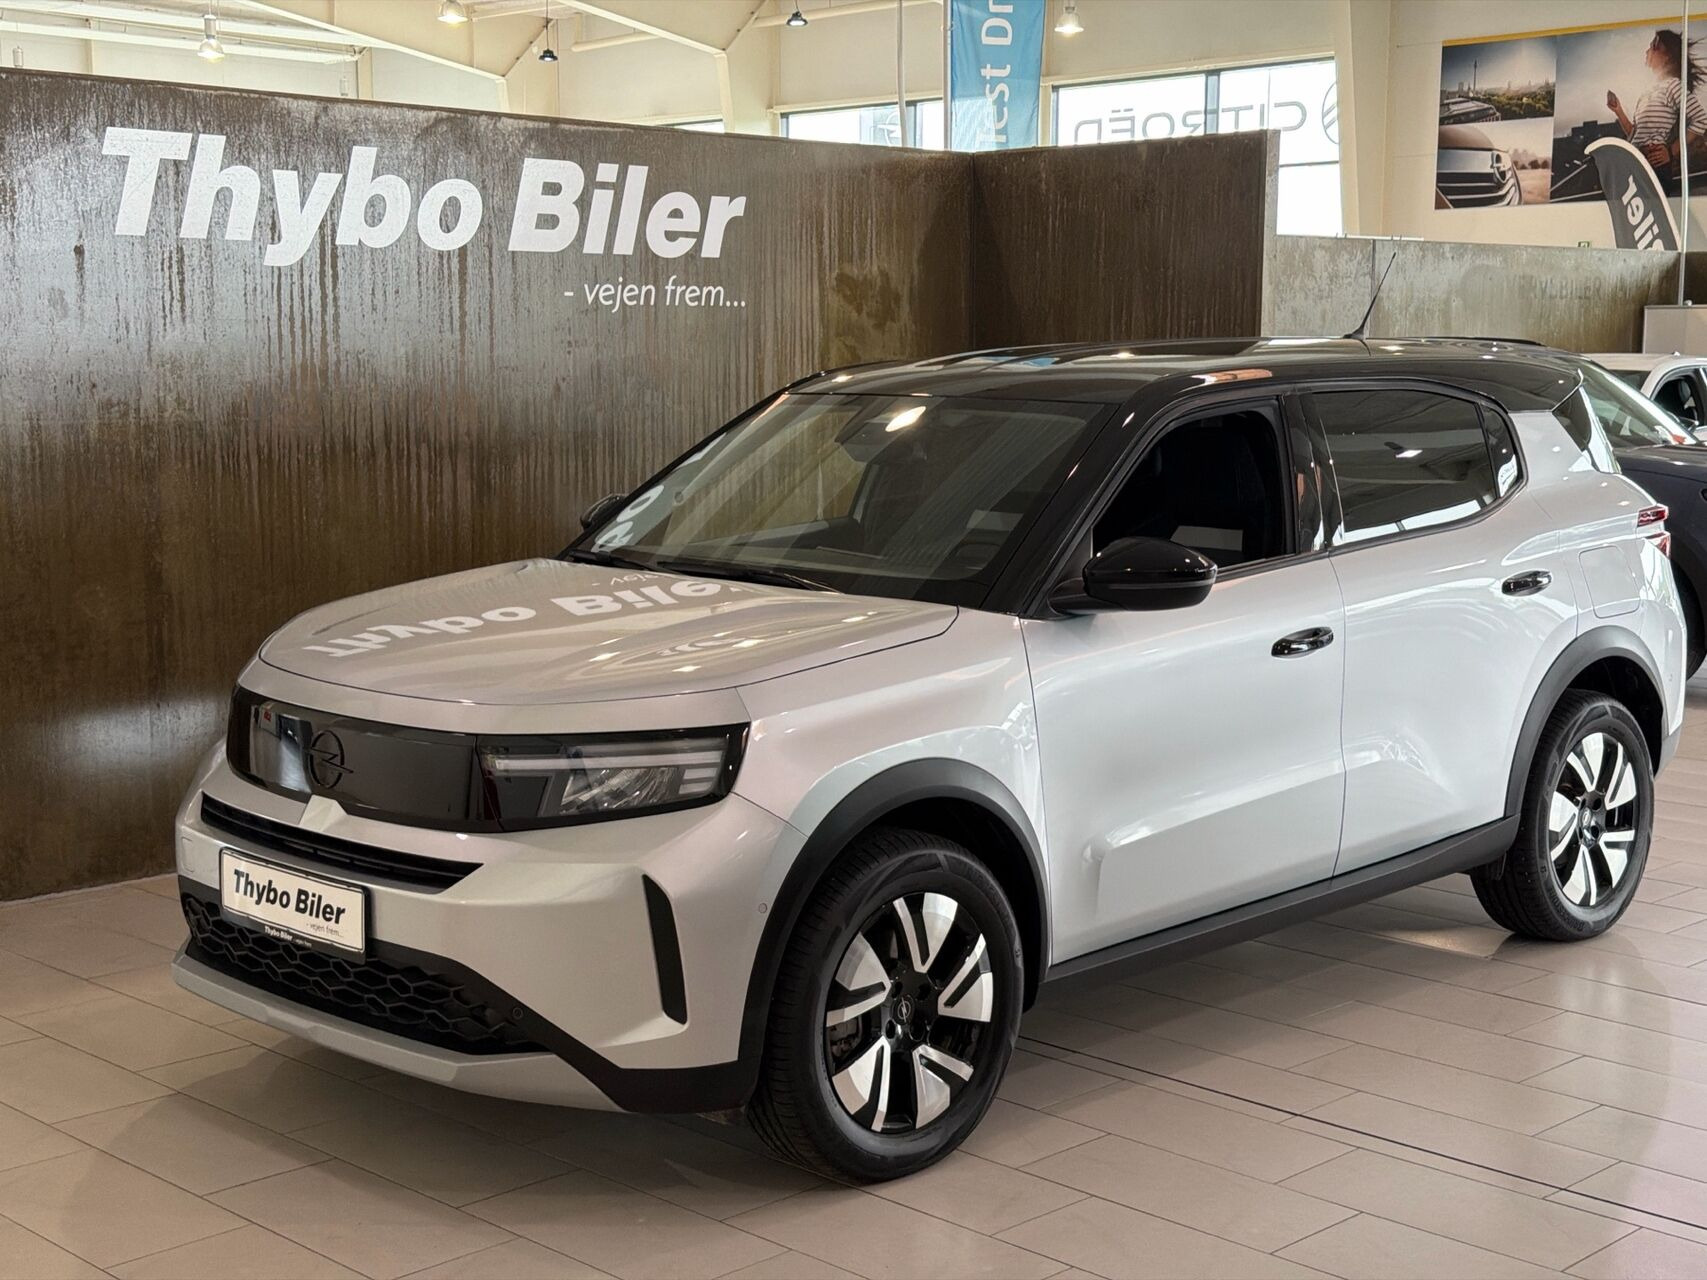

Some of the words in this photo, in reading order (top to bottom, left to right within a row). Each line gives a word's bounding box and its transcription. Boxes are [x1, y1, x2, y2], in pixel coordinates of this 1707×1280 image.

[101, 126, 484, 267] Thybo
[507, 157, 748, 260] Biler
[583, 275, 656, 314] vejen
[664, 274, 747, 308] frem...
[234, 868, 290, 907] Thybo
[295, 887, 345, 922] Biler
